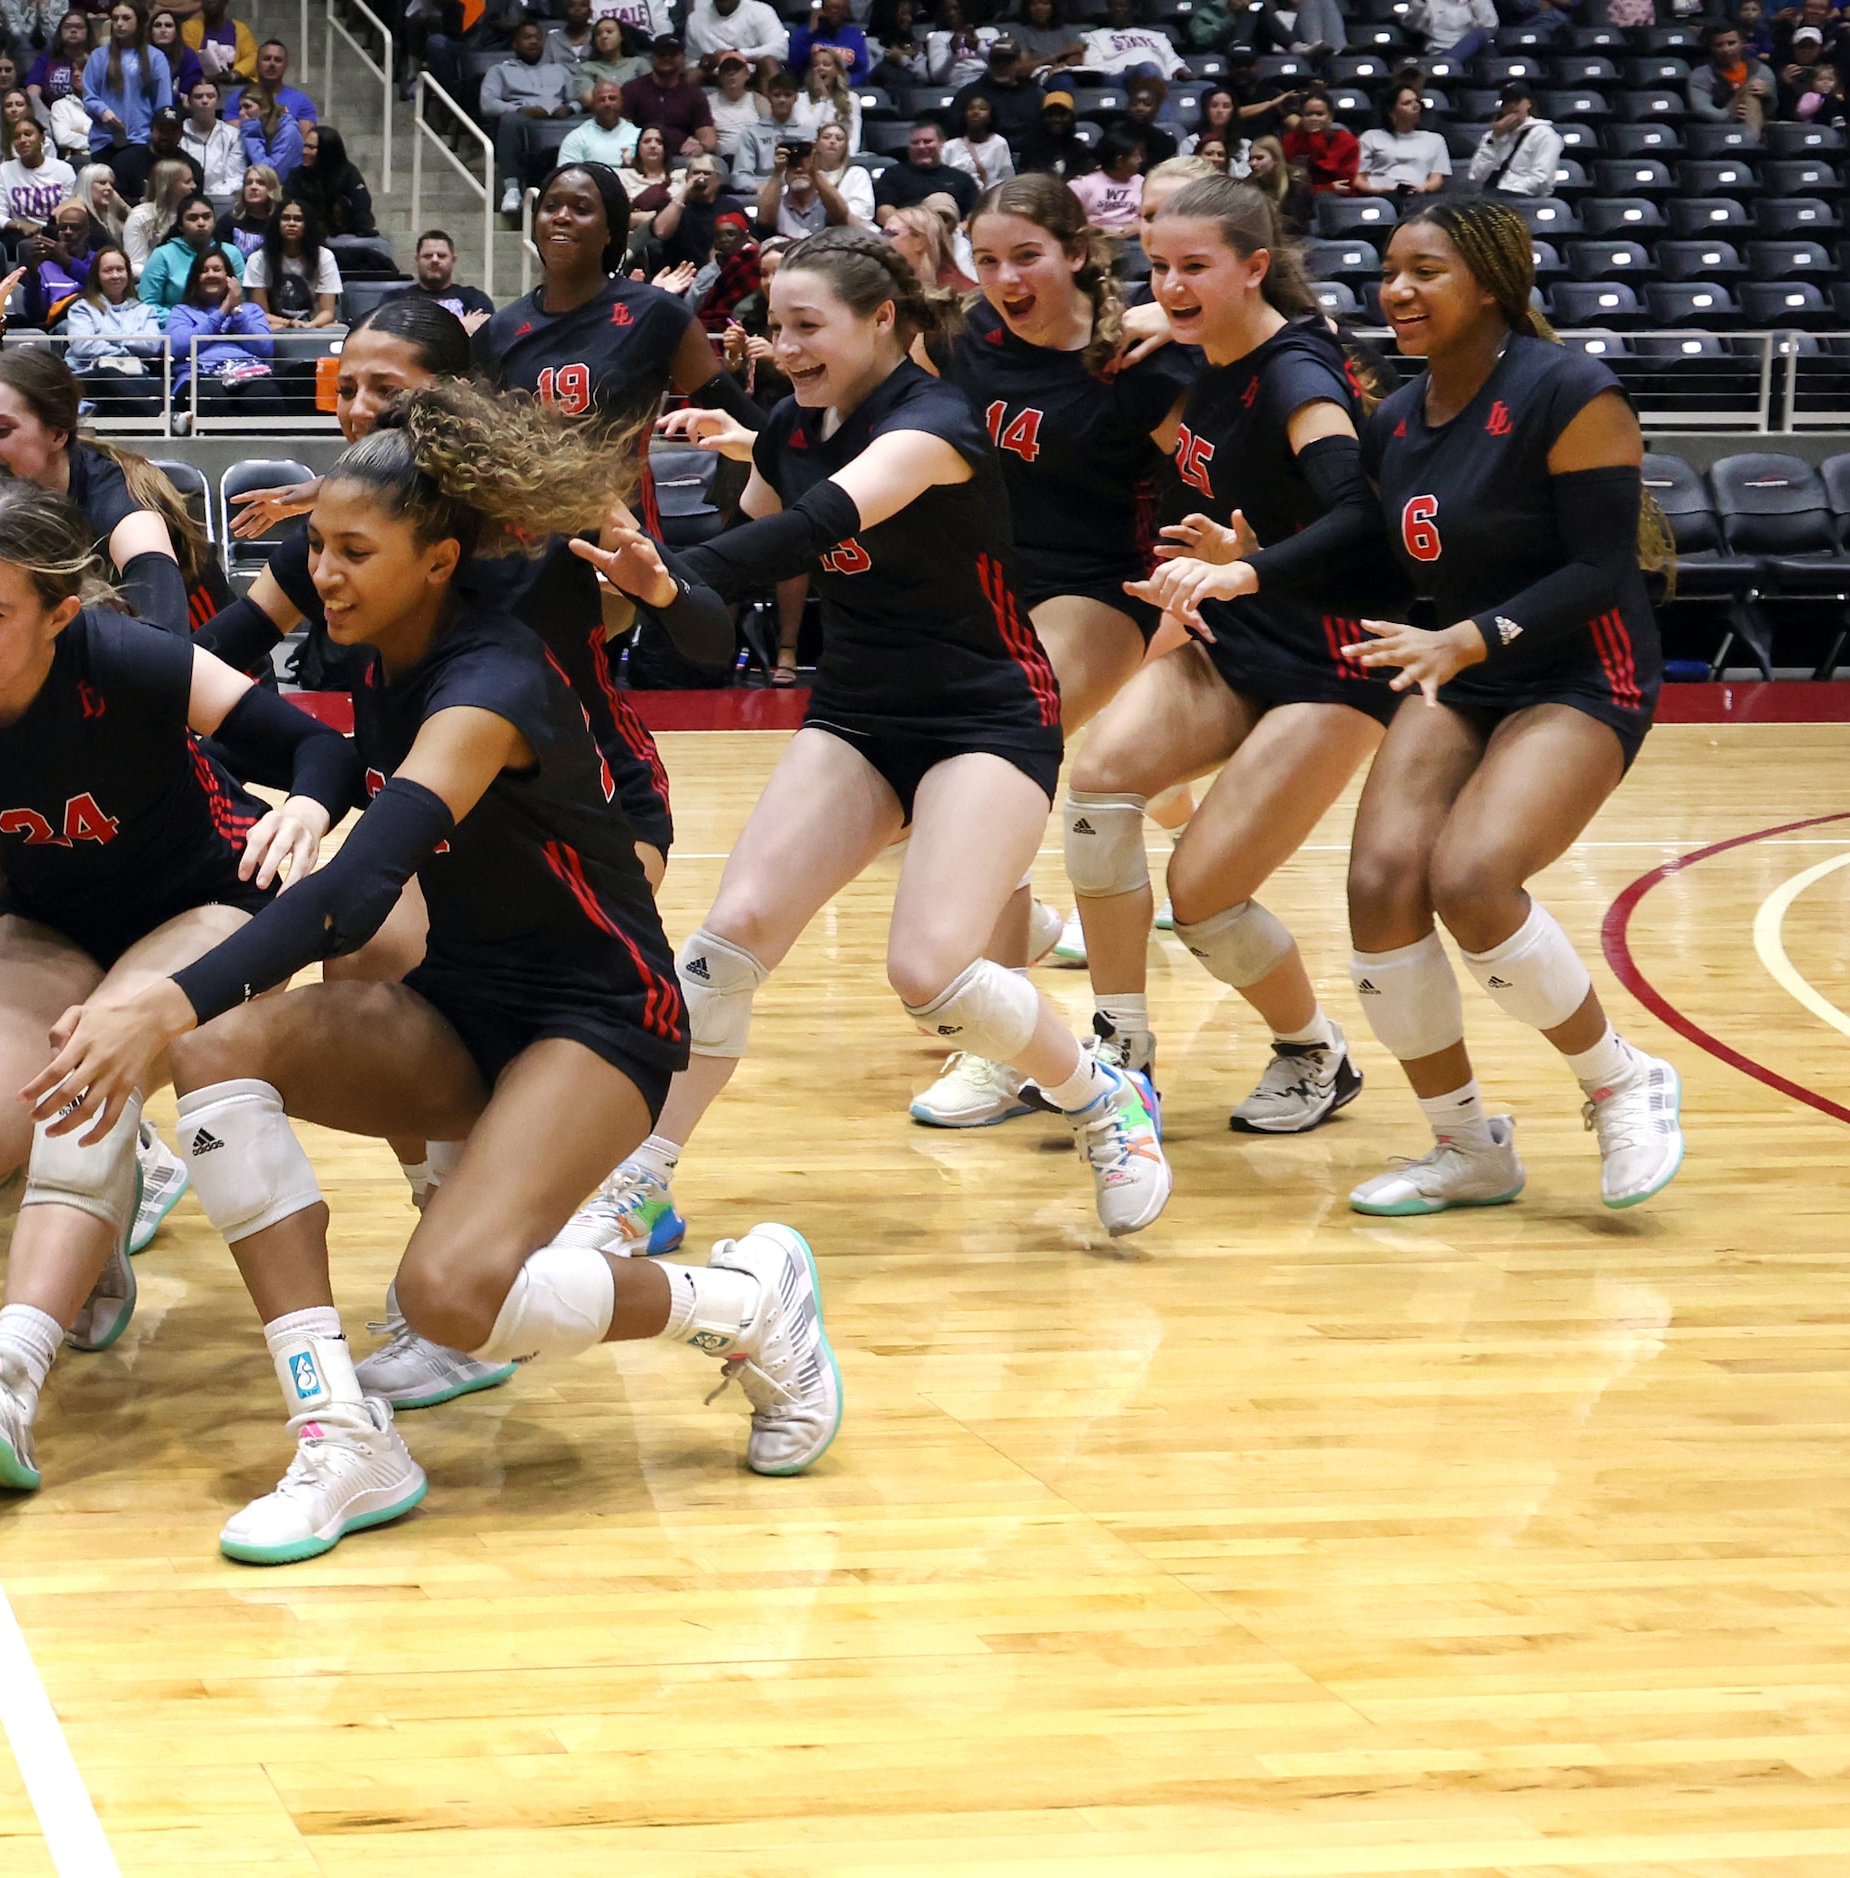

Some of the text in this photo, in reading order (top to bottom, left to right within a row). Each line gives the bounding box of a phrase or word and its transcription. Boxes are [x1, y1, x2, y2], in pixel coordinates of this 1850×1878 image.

[537, 363, 591, 415] 19
[985, 400, 1043, 462] 14
[1402, 494, 1442, 562] 6
[193, 1139, 225, 1156] adidas
